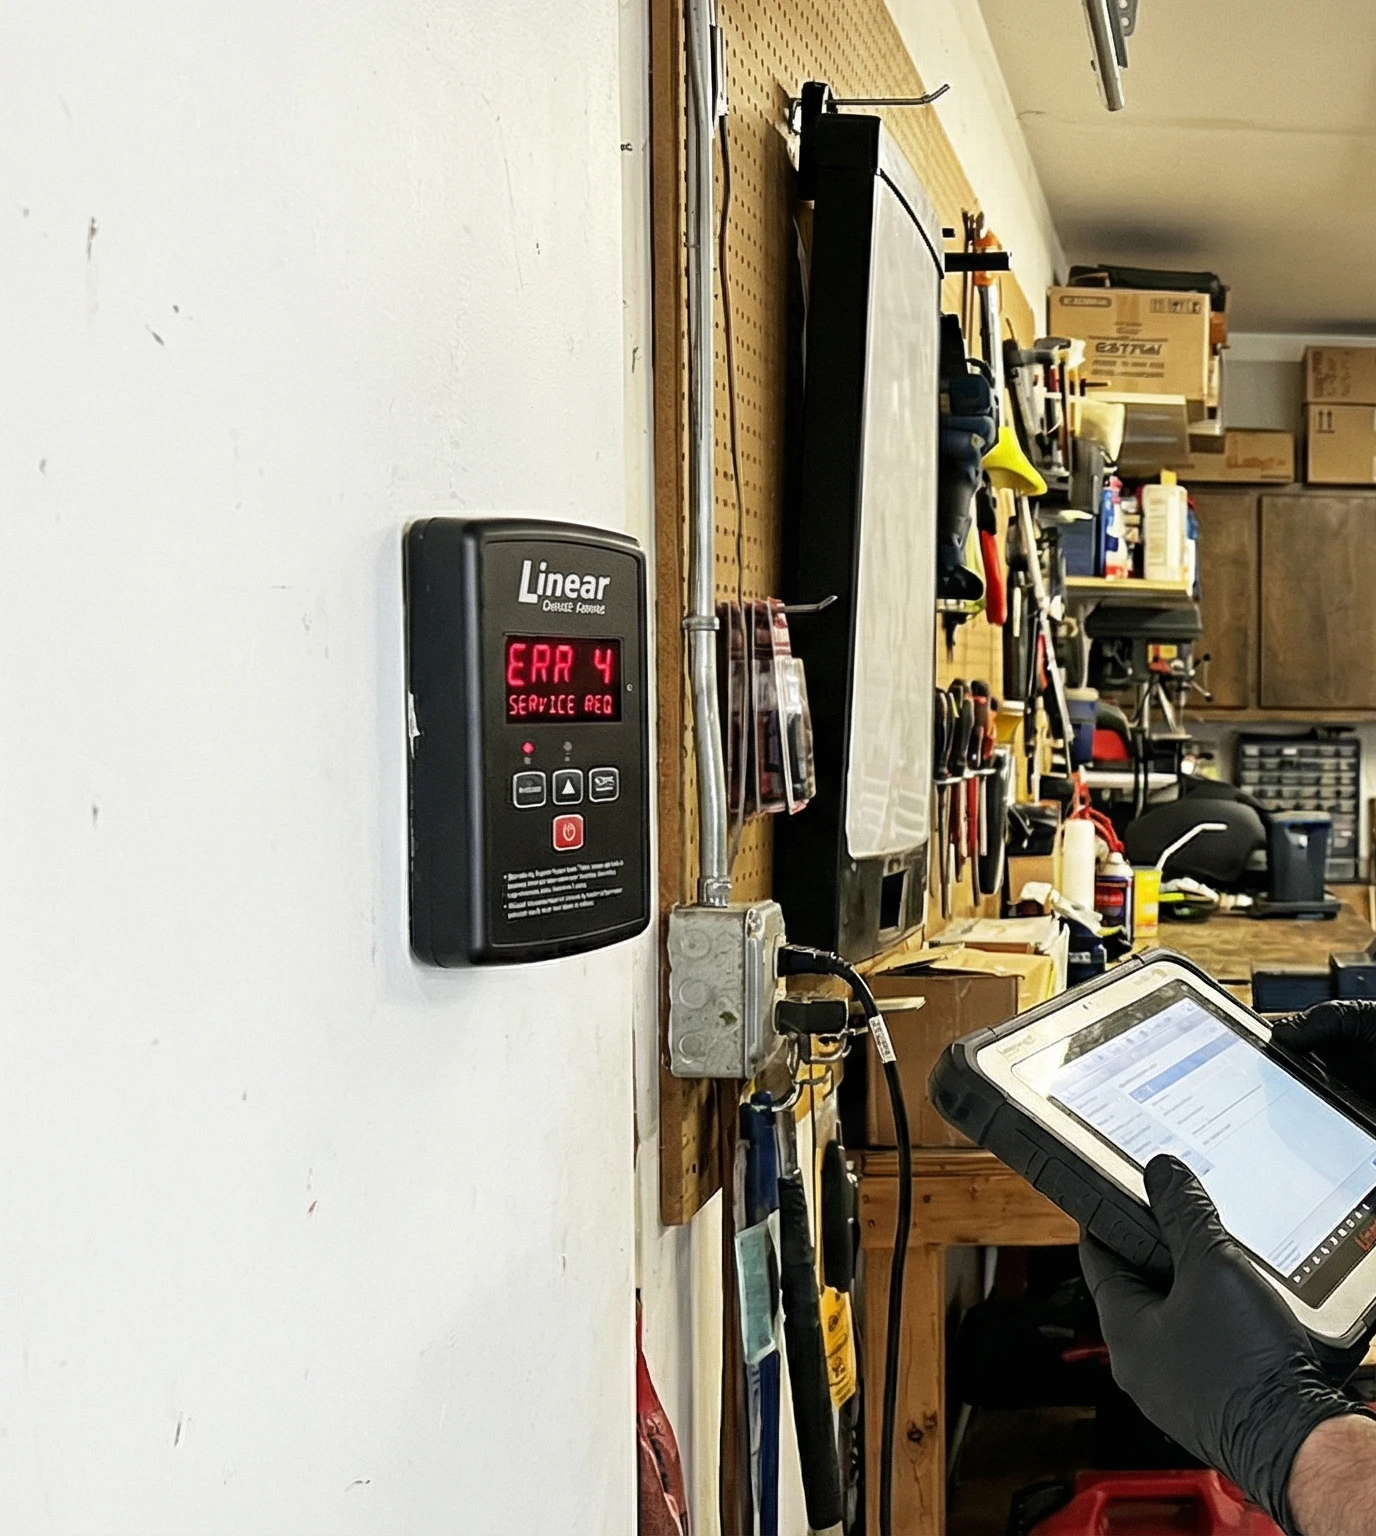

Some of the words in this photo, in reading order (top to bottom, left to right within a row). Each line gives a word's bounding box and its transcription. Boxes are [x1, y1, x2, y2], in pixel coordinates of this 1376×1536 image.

[518, 560, 611, 603] Linear
[507, 643, 573, 686] ERR
[594, 648, 612, 685] 4
[509, 694, 575, 715] SERVICE
[584, 694, 613, 715] REQ
